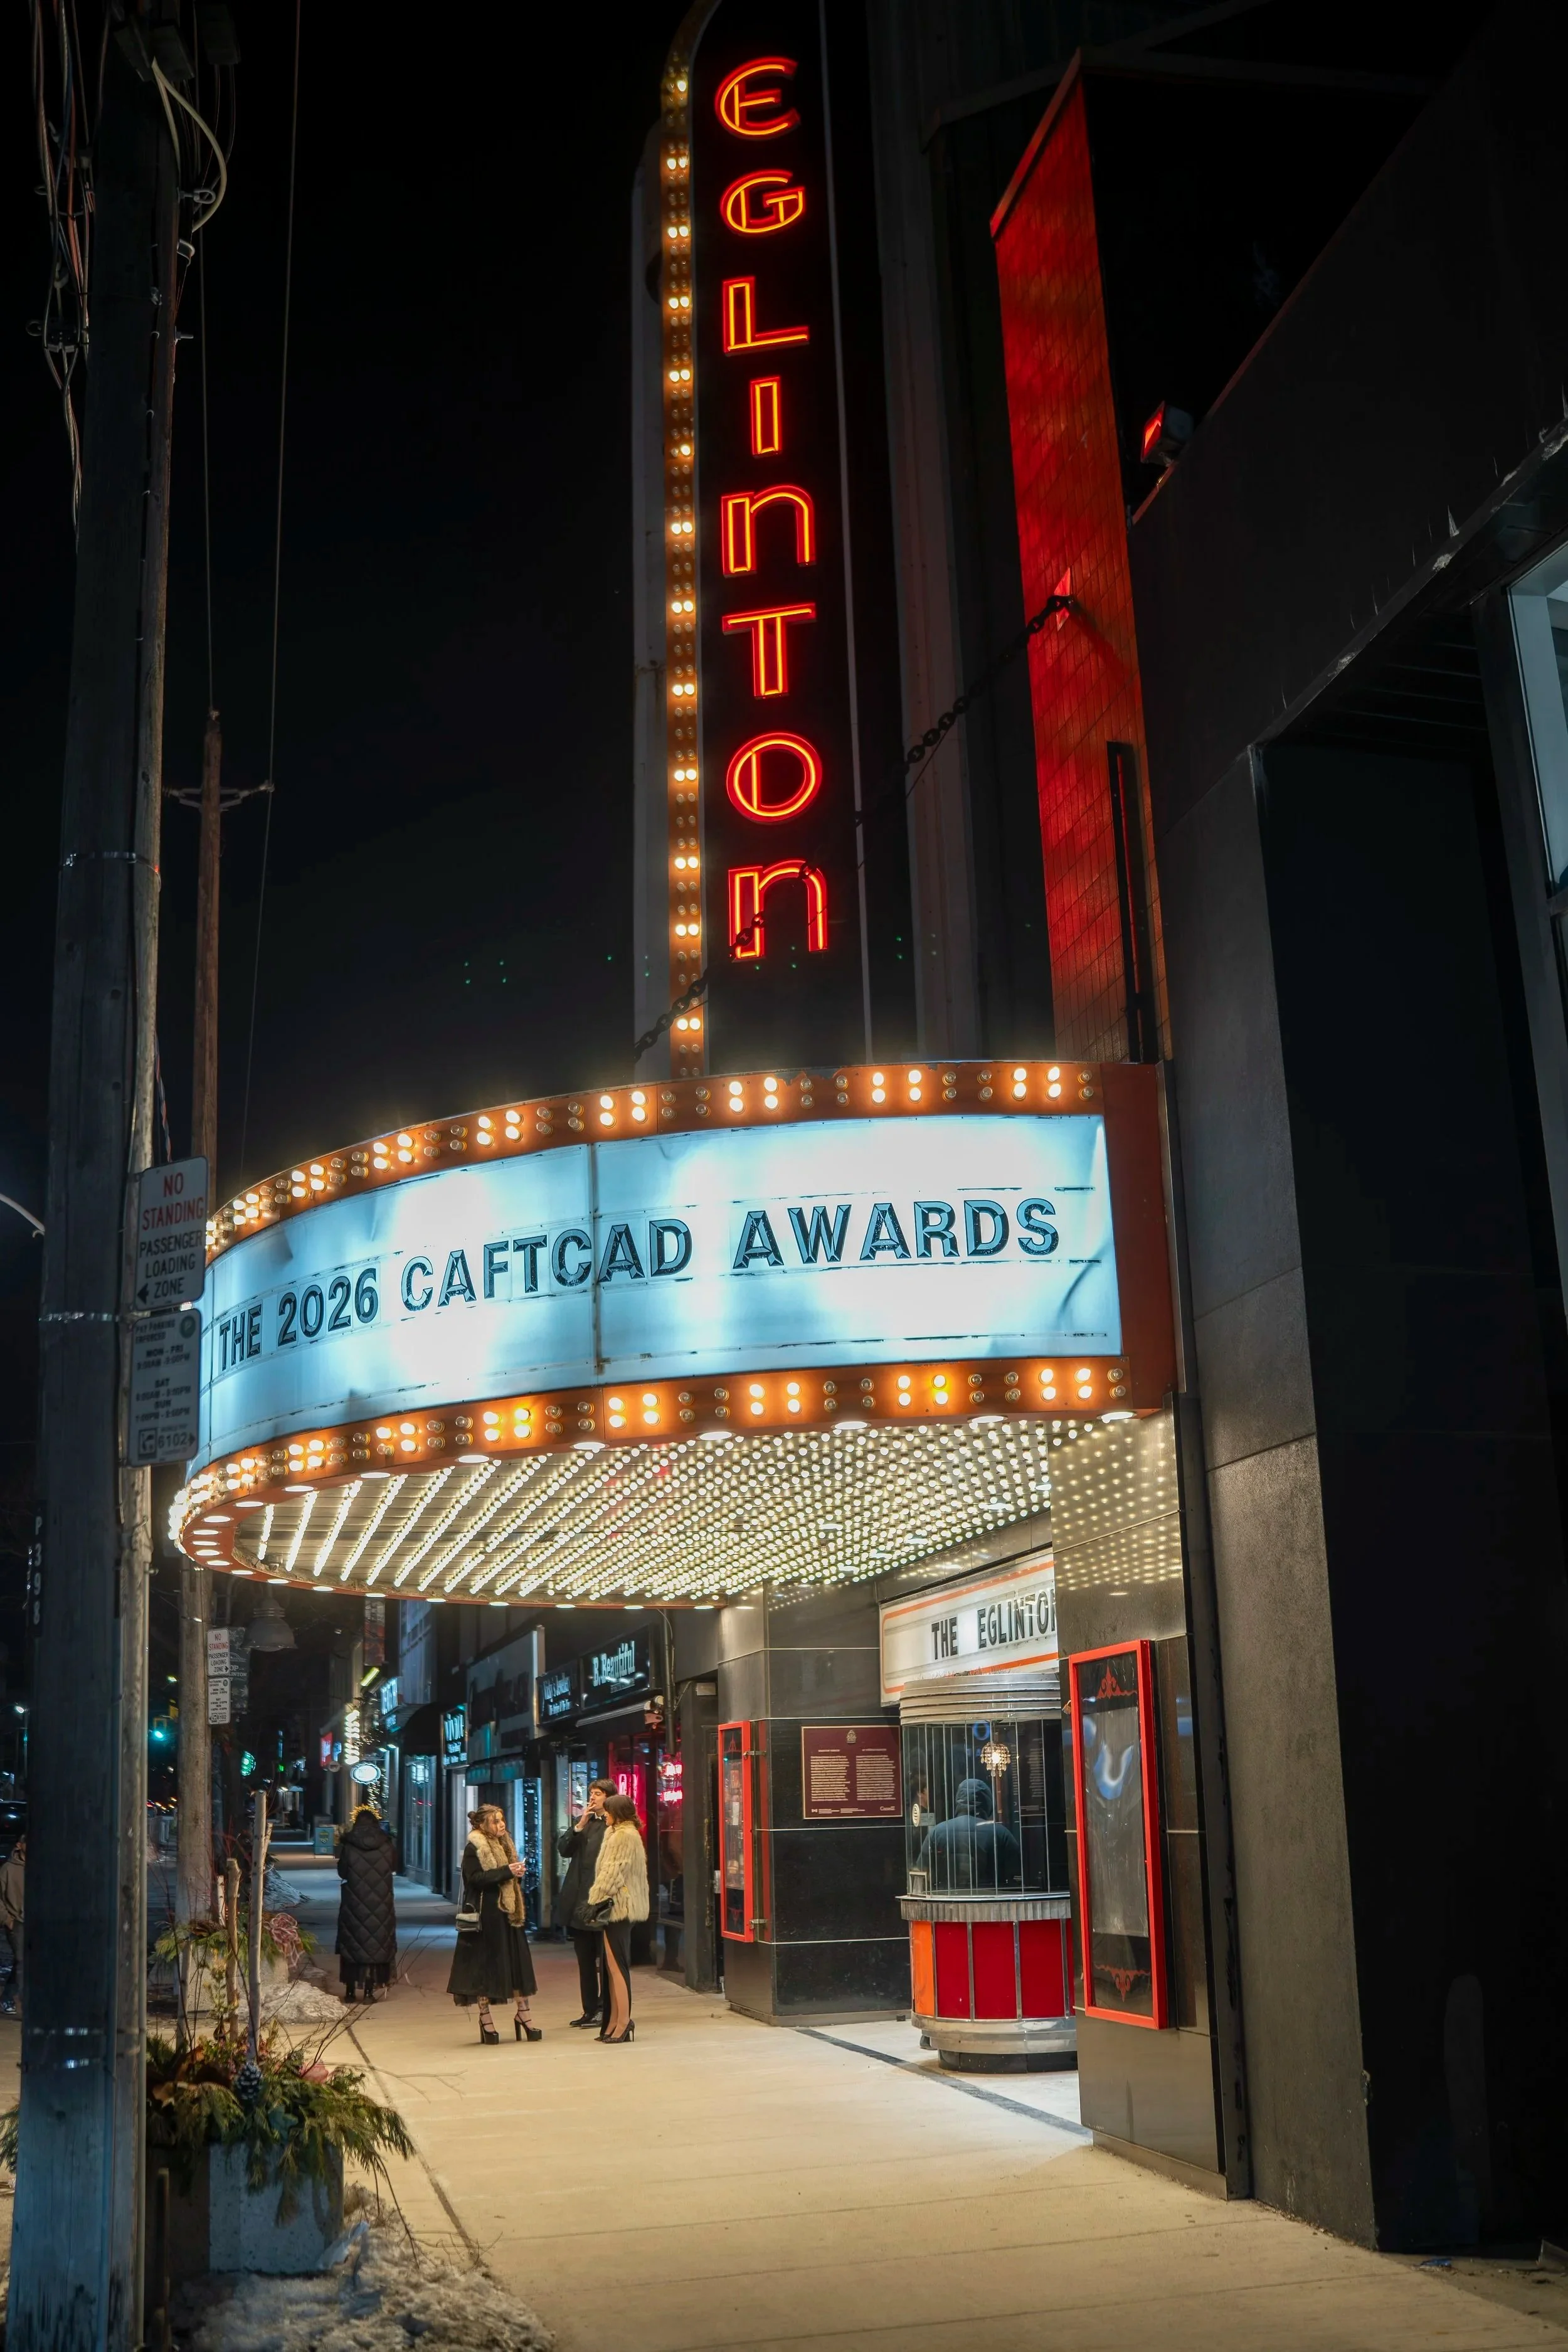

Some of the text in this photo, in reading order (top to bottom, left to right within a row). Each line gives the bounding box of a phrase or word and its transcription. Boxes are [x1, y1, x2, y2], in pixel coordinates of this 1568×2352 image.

[164, 1172, 184, 1197] NO
[142, 1197, 204, 1231] STANDING
[139, 1230, 203, 1258] PASSENGER
[145, 1253, 196, 1279] LOADING
[154, 1277, 185, 1299] ZONE
[220, 1198, 1060, 1371] THE 2026 CAFTCAD AWARDS
[158, 1432, 188, 1449] 6102
[209, 1641, 228, 1651] STANDING
[215, 1633, 222, 1641] NO
[931, 1616, 958, 1660] THE
